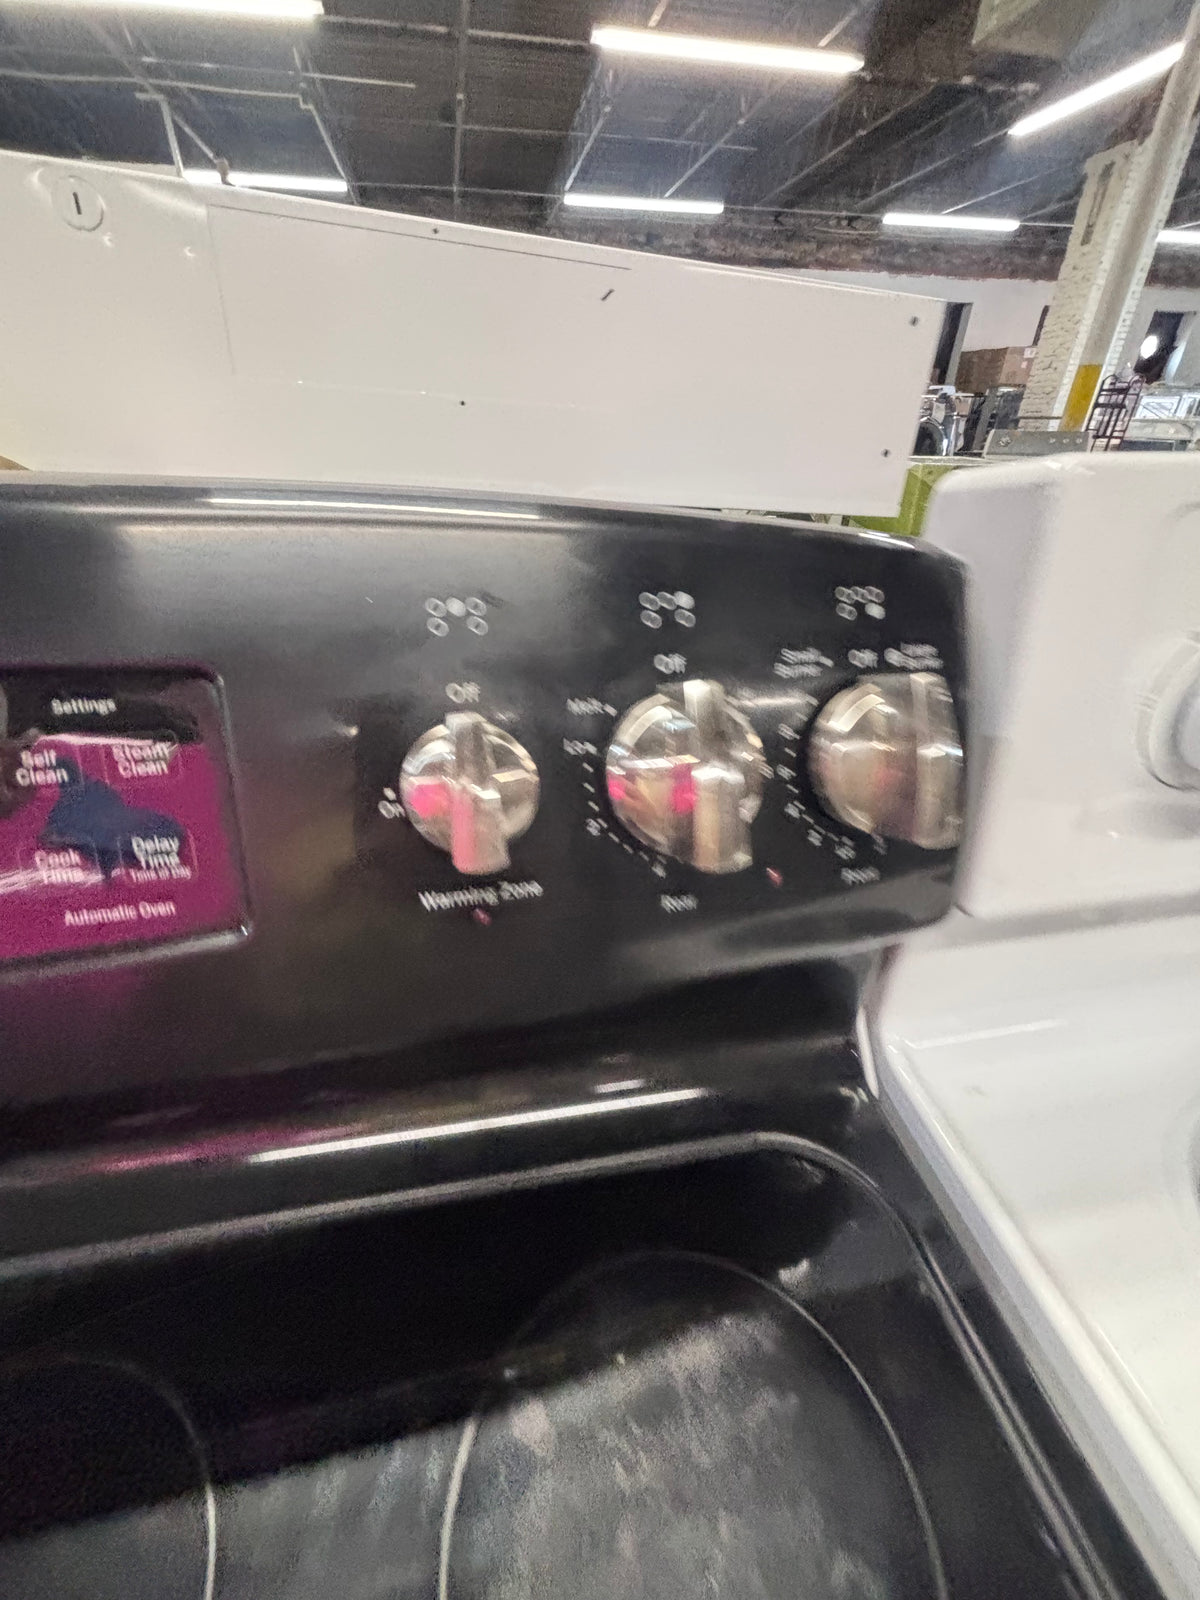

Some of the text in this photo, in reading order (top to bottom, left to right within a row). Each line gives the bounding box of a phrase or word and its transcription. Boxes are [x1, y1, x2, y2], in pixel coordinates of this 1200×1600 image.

[51, 697, 117, 716] Settings
[20, 750, 57, 768] Self
[15, 767, 69, 787] Clean
[117, 760, 169, 778] Clean
[131, 835, 180, 857] Delay
[65, 900, 176, 927] Automatic Oven
